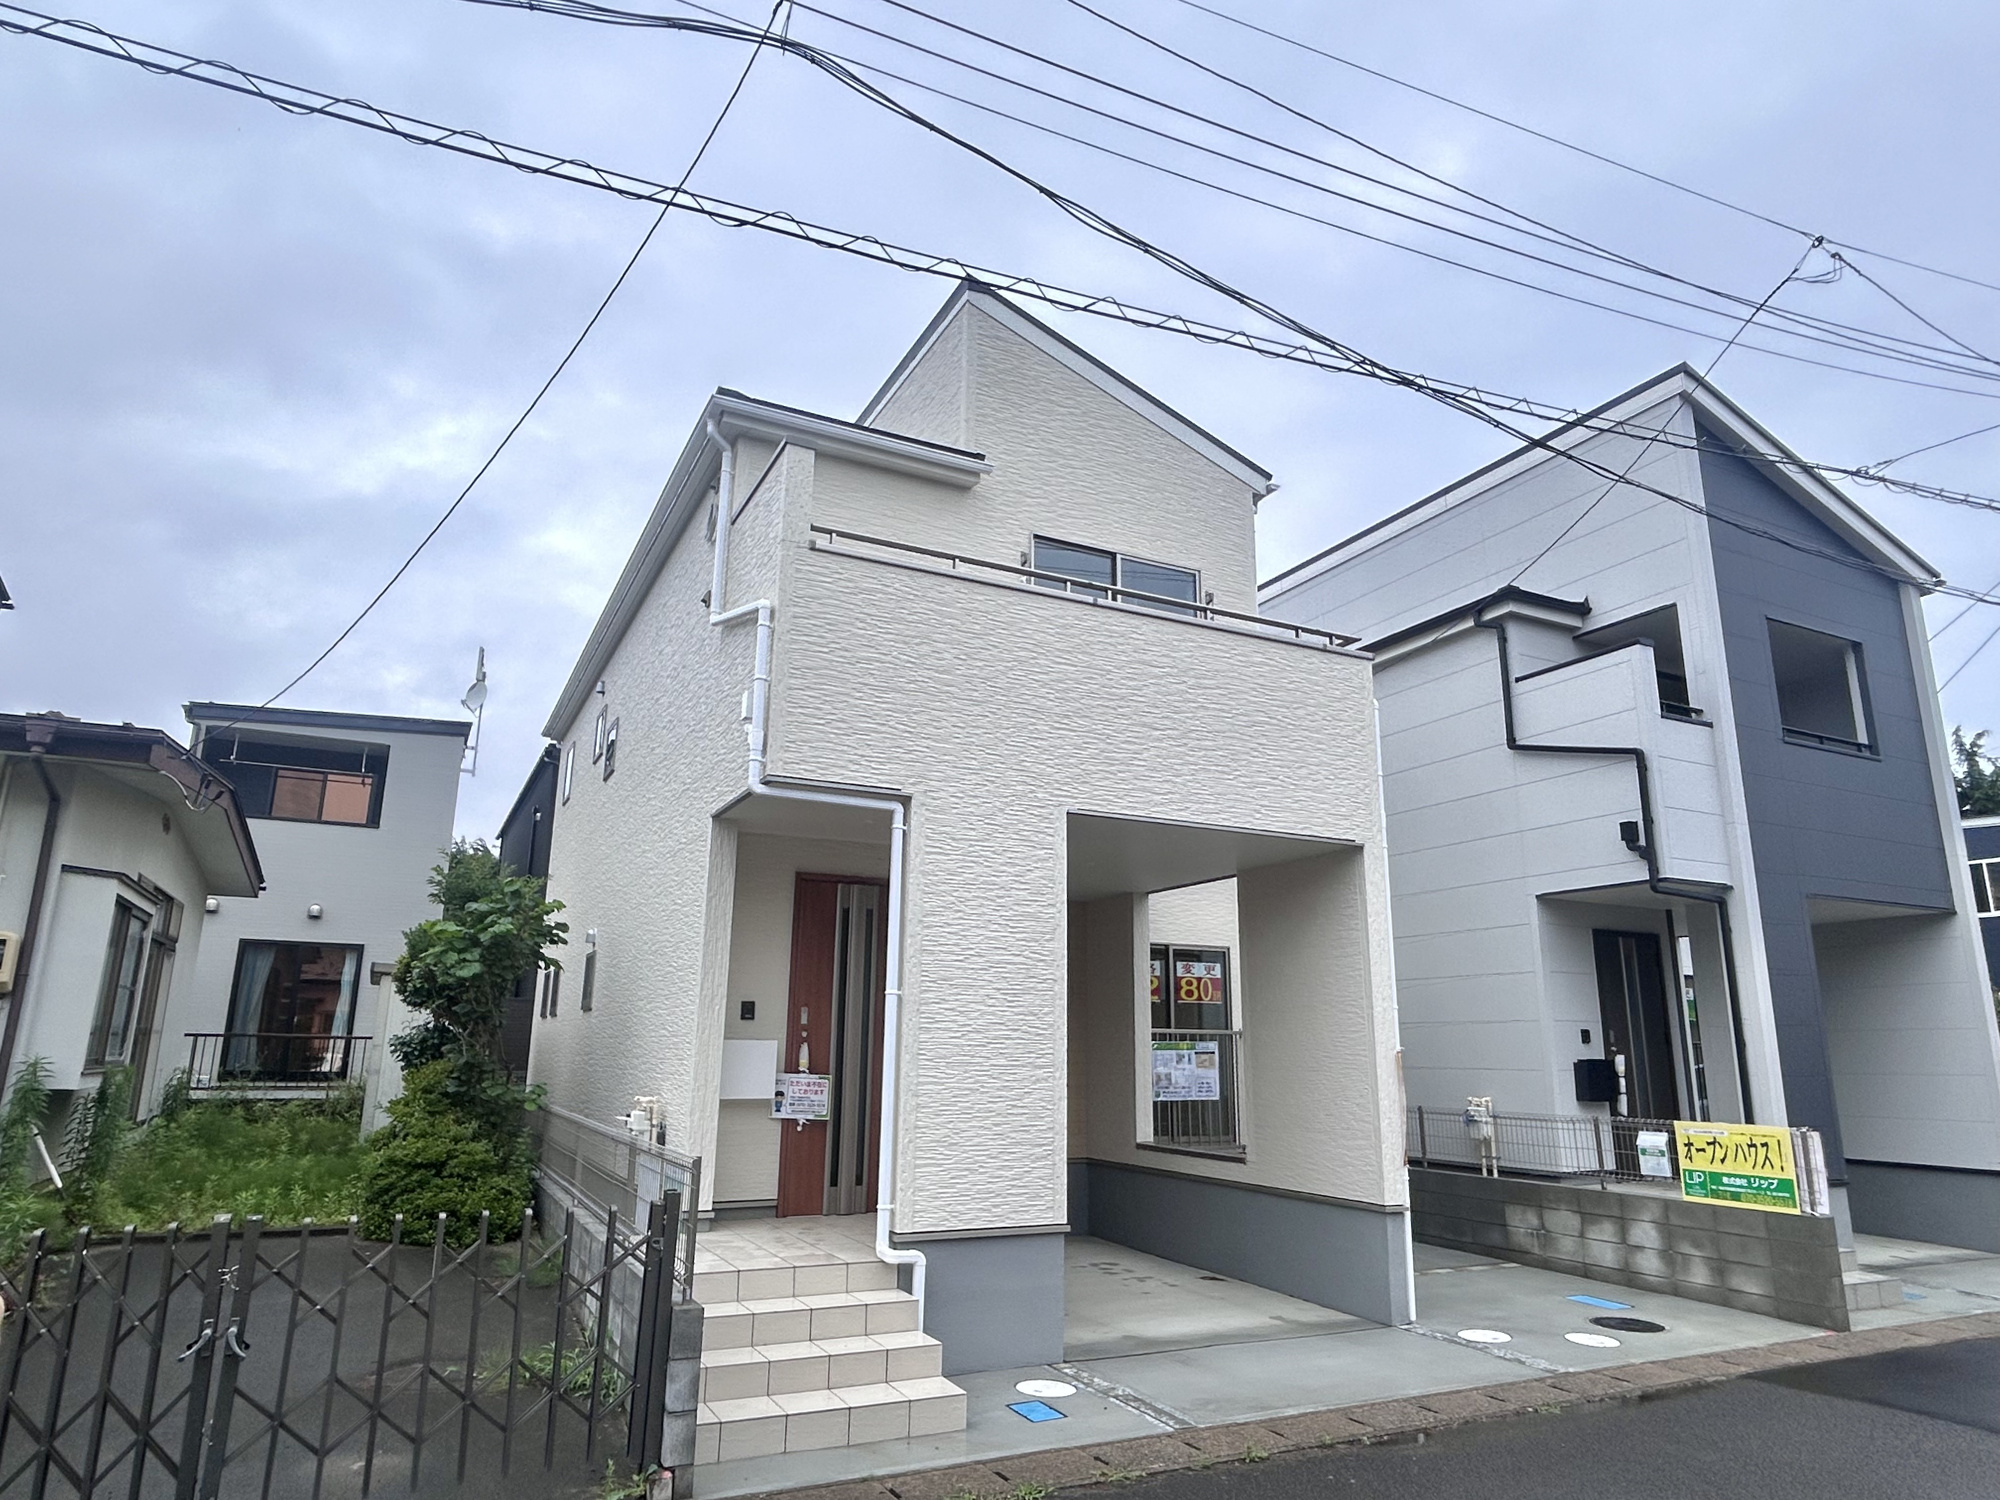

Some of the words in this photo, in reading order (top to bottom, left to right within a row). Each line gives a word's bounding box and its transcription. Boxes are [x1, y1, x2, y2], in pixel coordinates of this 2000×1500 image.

[1181, 962, 1217, 977] 変更
[1751, 1177, 1779, 1189] リップ
